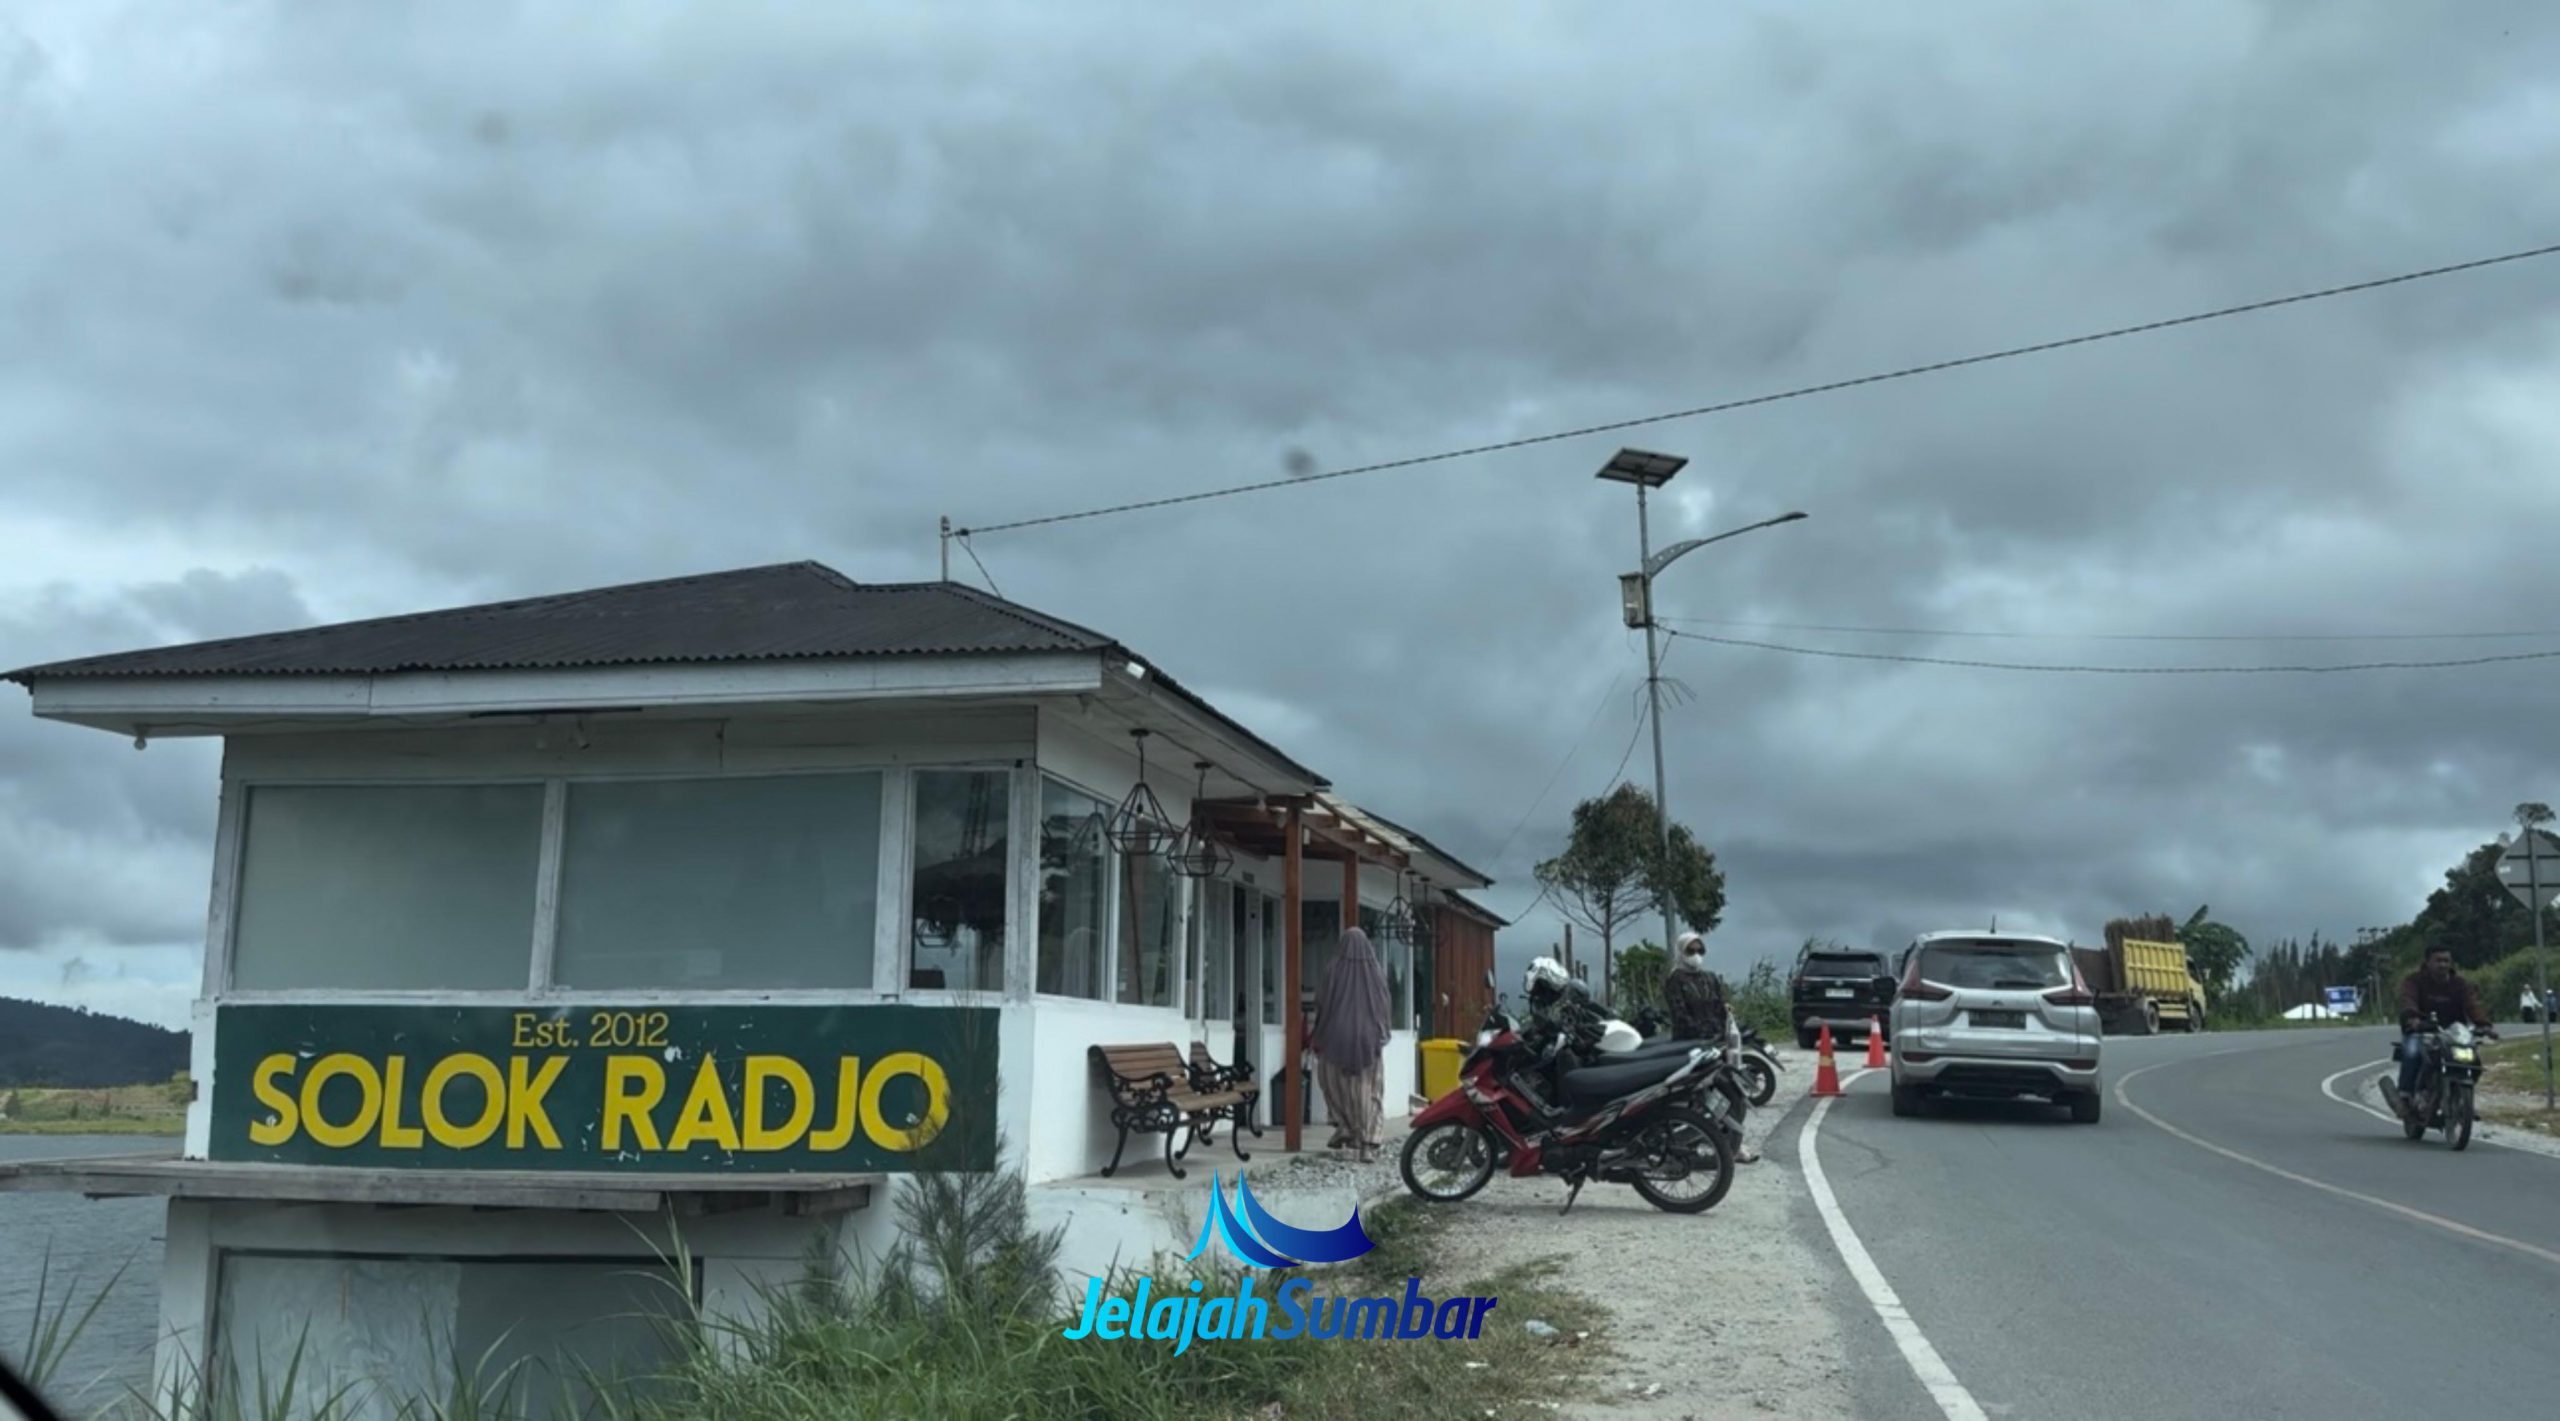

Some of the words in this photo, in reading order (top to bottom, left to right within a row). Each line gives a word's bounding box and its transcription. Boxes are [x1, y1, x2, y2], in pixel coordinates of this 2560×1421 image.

[513, 1012, 579, 1048] Est.
[589, 1012, 669, 1048] 2012
[249, 1052, 570, 1149] SOLOK
[602, 1052, 951, 1152] RADJO
